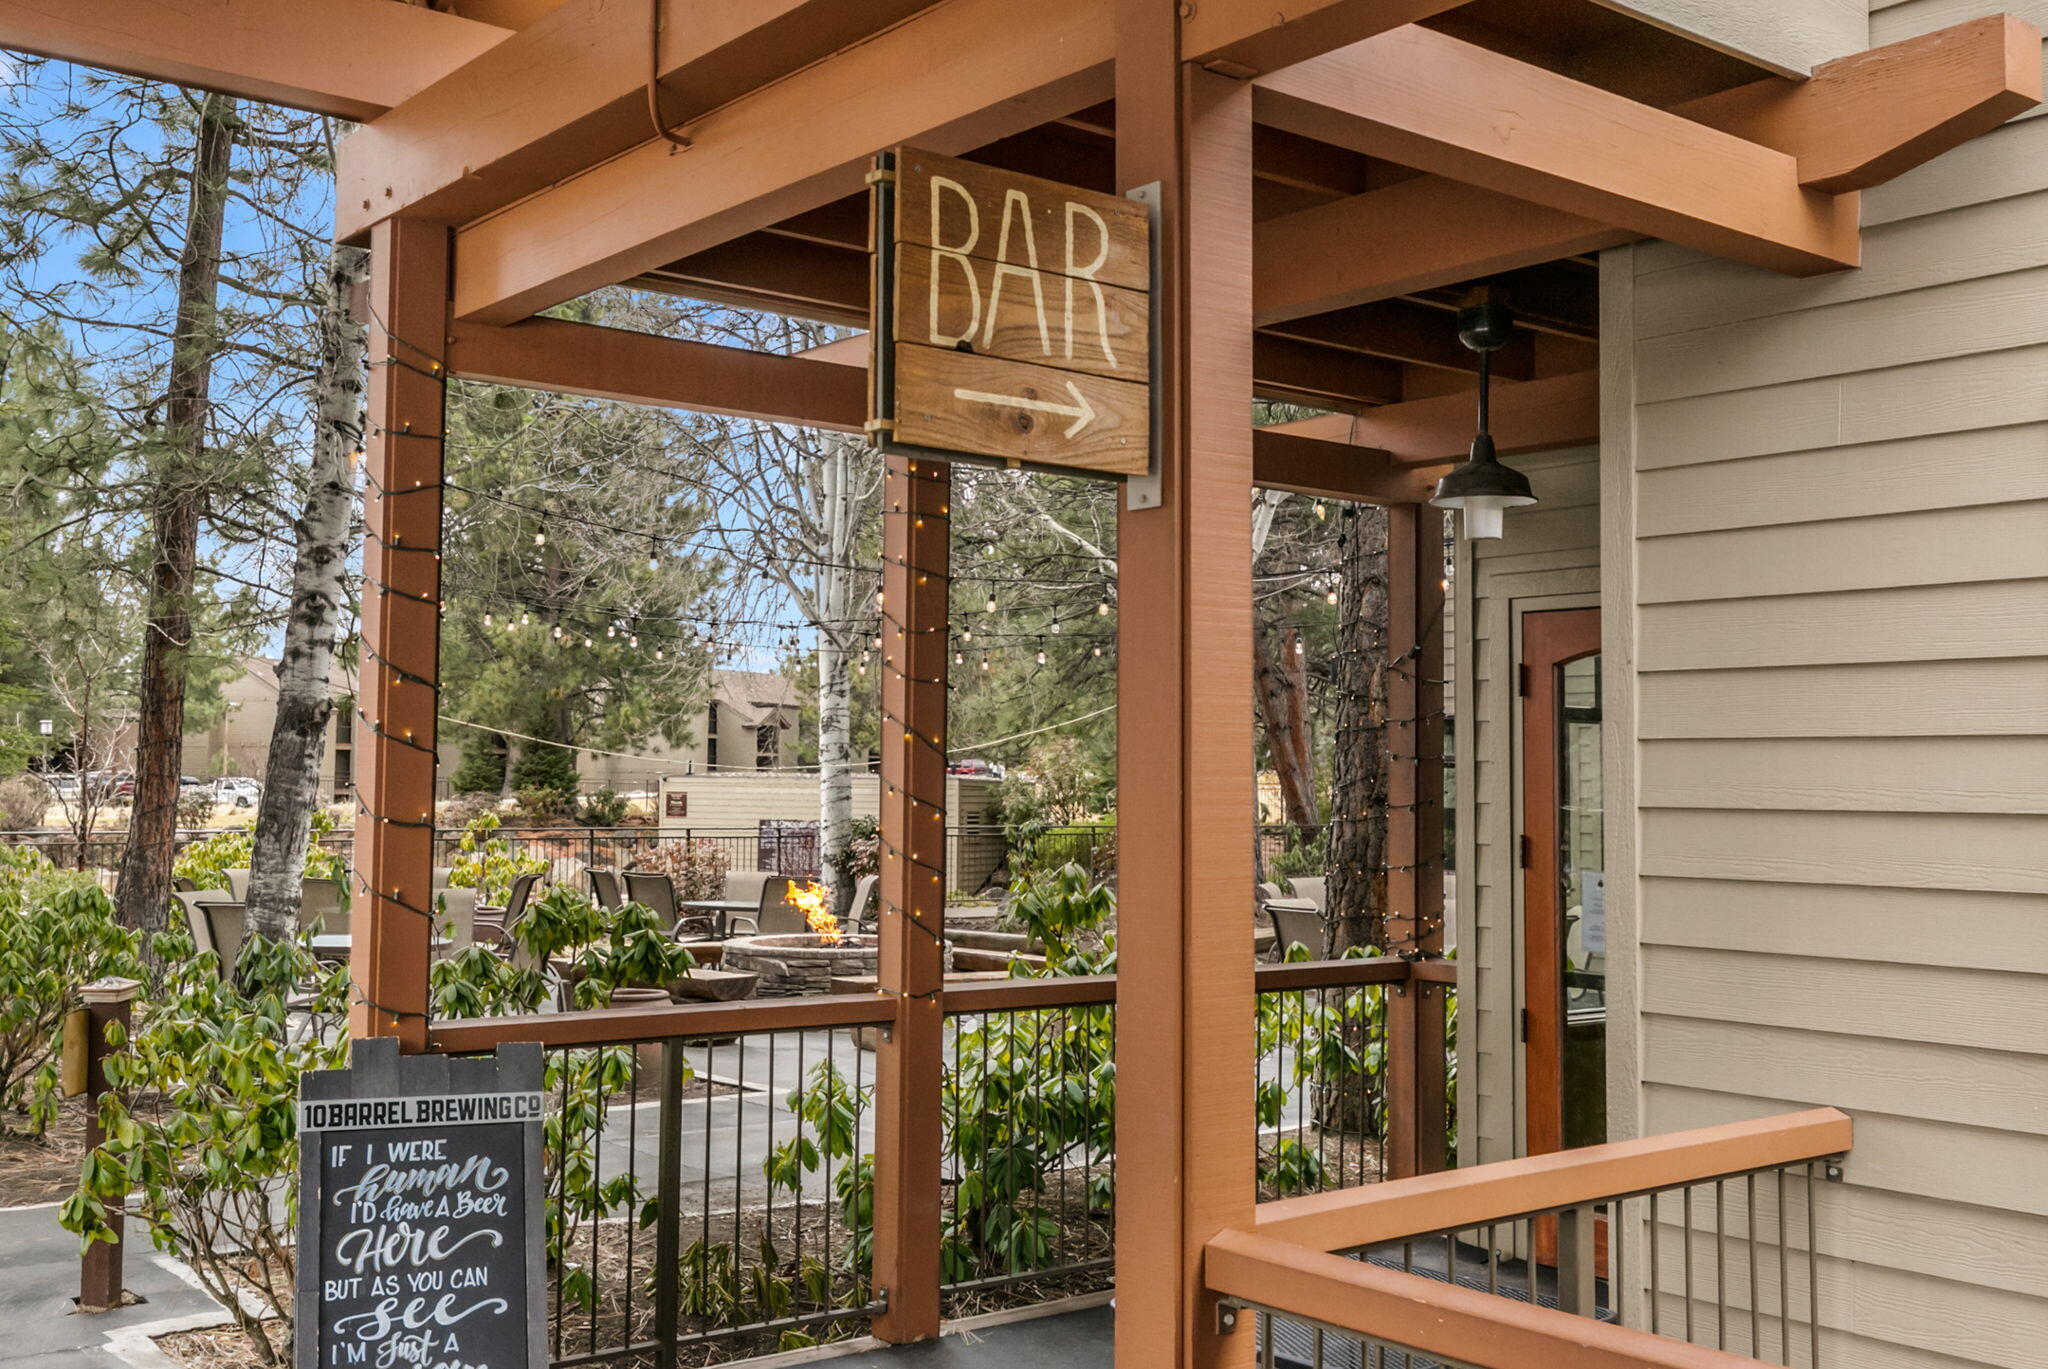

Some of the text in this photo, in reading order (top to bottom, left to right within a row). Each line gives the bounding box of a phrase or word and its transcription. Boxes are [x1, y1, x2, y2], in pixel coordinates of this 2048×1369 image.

[929, 176, 1117, 369] BAR
[304, 1104, 326, 1129] 10
[328, 1101, 413, 1127] BARREL
[416, 1097, 512, 1123] BREWING
[331, 1138, 448, 1168] IF I WERE
[333, 1155, 509, 1206] human
[350, 1190, 508, 1224] I'D have A Beer
[336, 1221, 503, 1274] Here
[324, 1266, 488, 1302] BUT AS YOU CAN
[331, 1341, 367, 1366] I'M
[443, 1332, 460, 1354] A
